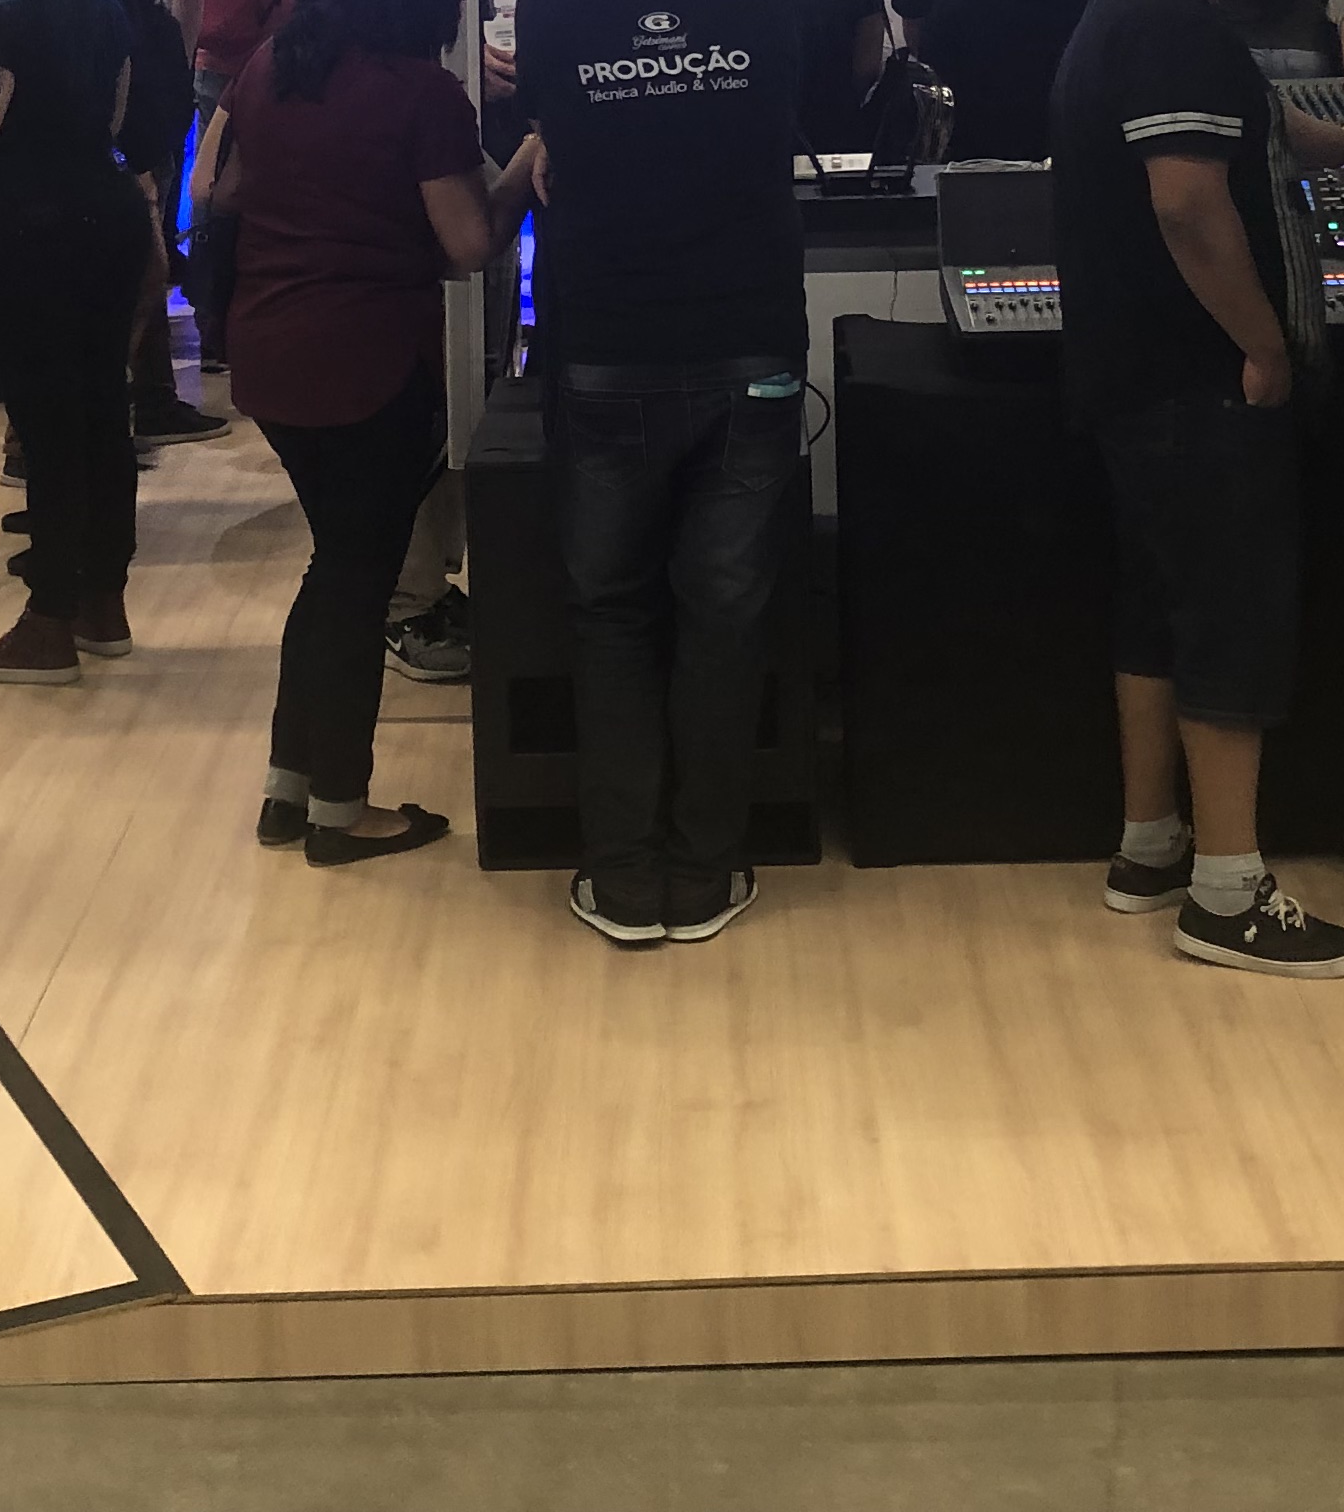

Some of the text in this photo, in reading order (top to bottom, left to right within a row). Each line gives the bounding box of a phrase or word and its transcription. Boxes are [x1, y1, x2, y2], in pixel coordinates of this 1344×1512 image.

[578, 45, 751, 85] PRODUÇÃO
[587, 86, 638, 103] Técnica
[644, 80, 688, 96] Áudio
[693, 79, 705, 91] &
